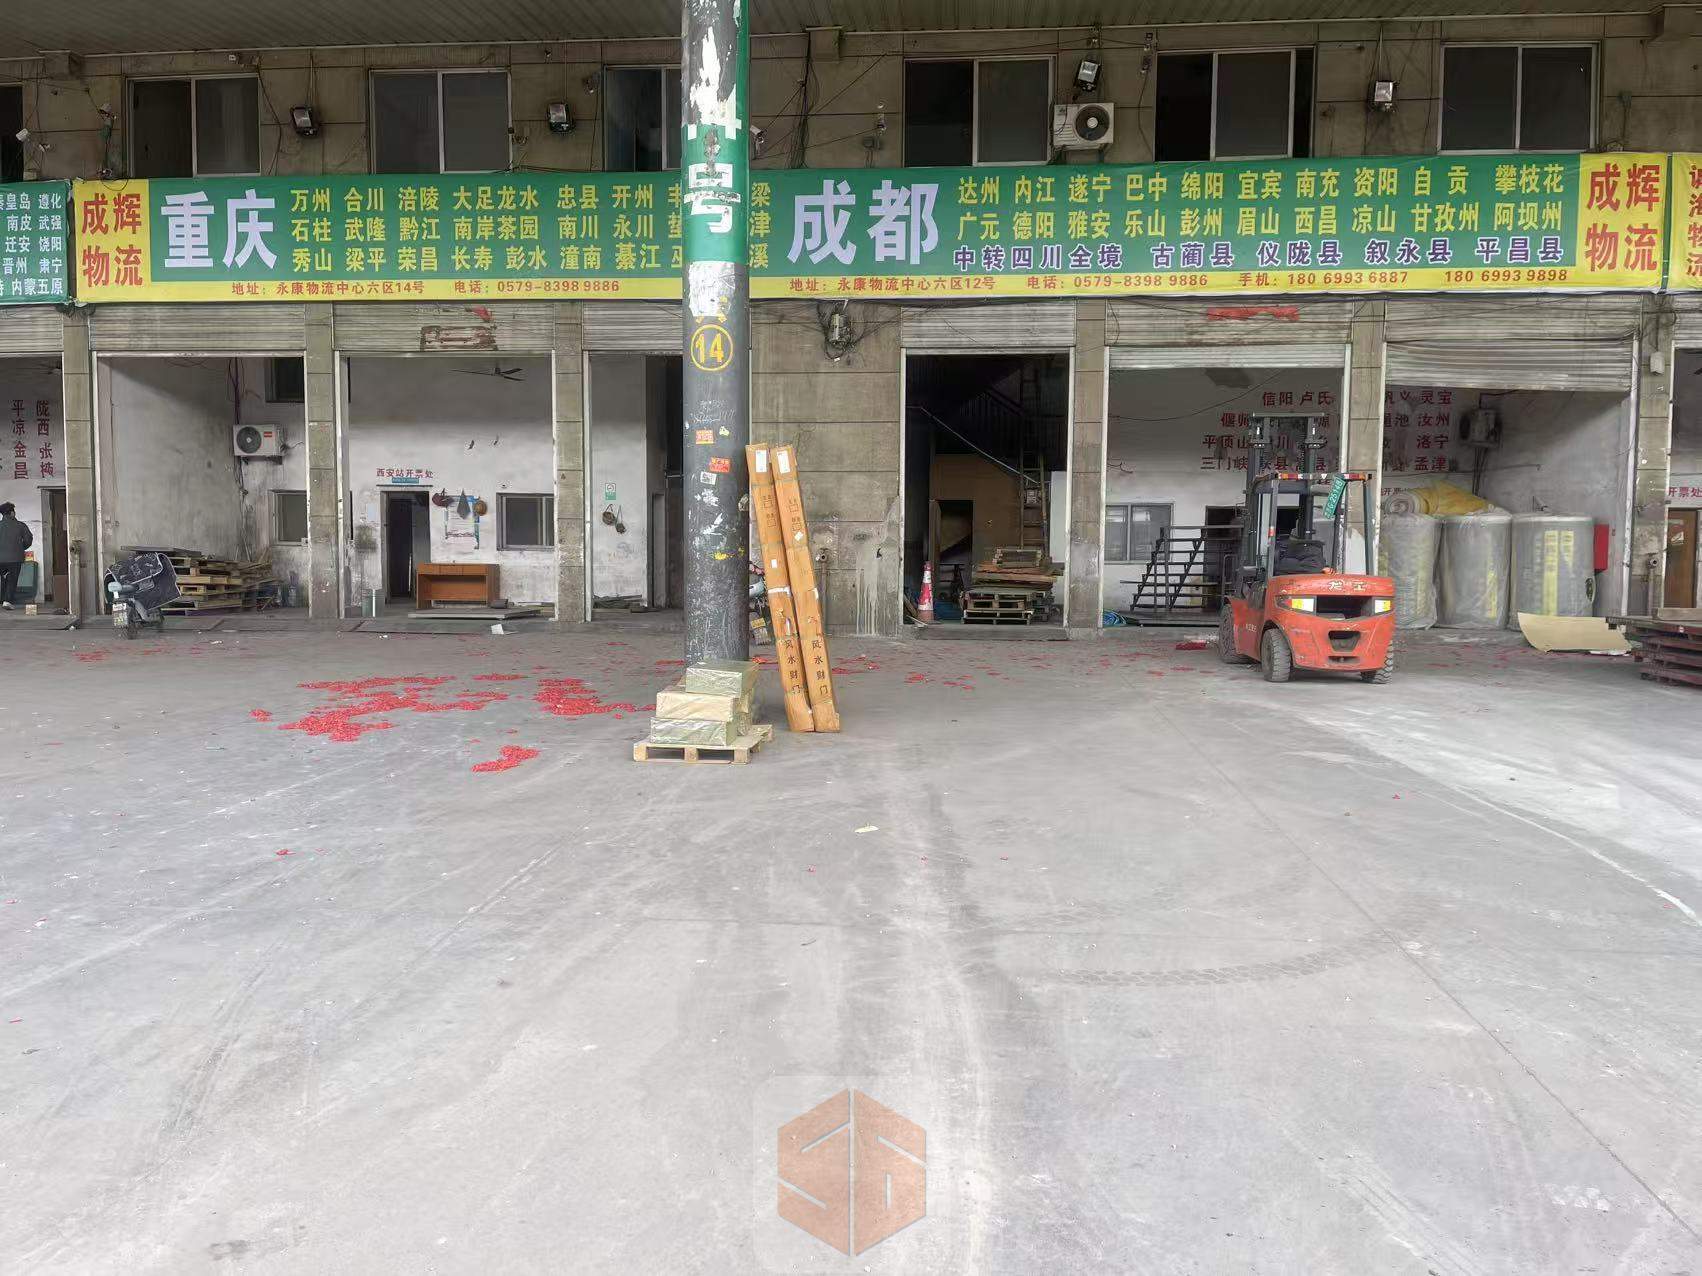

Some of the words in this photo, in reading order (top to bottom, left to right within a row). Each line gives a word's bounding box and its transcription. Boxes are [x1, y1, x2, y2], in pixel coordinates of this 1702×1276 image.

[290, 188, 331, 212] 万州
[344, 187, 384, 212] 合川
[398, 186, 440, 211] 涪陵
[452, 184, 539, 210] 大足龙水
[557, 184, 600, 210] 忠县
[612, 184, 653, 209] 开州
[958, 176, 1000, 204] 达州
[1014, 176, 1056, 203] 内江
[1068, 174, 1112, 202] 遂宁
[1125, 172, 1168, 202] 巴中
[1181, 171, 1224, 200] 绵阳
[1238, 170, 1282, 200] 宜宾
[1296, 168, 1339, 199] 南充
[1354, 167, 1398, 198] 资阳
[1495, 163, 1565, 195] 攀枝花
[1586, 162, 1660, 213] 成辉
[39, 193, 62, 210] 遵化
[81, 192, 142, 235] 成辉
[7, 214, 32, 232] 南皮
[39, 215, 62, 231] 武强
[160, 188, 278, 269] 重庆
[291, 218, 332, 243] 石柱
[344, 218, 386, 242] 武隆
[398, 216, 441, 240] 黔江
[453, 215, 540, 240] 南岸茶园
[557, 215, 600, 240] 南川
[612, 214, 654, 239] 永川
[787, 179, 940, 265] 成都
[957, 212, 1000, 240] 广元
[1013, 211, 1056, 239] 德阳
[1068, 209, 1112, 239] 雅安
[1124, 208, 1167, 238] 乐山
[1180, 207, 1223, 237] 彭州
[1237, 206, 1280, 236] 眉山
[1294, 206, 1337, 235] 西昌
[1352, 204, 1396, 234] 凉山
[1411, 201, 1479, 233] 甘孜州
[1494, 201, 1563, 232] 阿坝州
[5, 235, 31, 253] 迁安
[39, 236, 62, 252] 饶阳
[293, 247, 332, 272] 秀山
[346, 247, 387, 272] 梁平
[398, 247, 439, 272] 荣昌
[451, 247, 493, 270] 长寿
[506, 246, 548, 269] 彭水
[560, 246, 602, 270] 潼南
[615, 242, 662, 270] 綦江
[953, 244, 1123, 271] 中转四川全境
[1151, 241, 1235, 268] 古蔺县
[1257, 241, 1342, 267] 仪陇县
[1365, 237, 1452, 265] 叙永县
[1475, 236, 1564, 264] 平昌县
[1585, 222, 1659, 273] 物流
[2, 257, 28, 275] 晋州
[39, 258, 63, 274] 肃宁
[81, 246, 144, 287] 物流
[11, 278, 63, 296] 内蒙五原
[695, 333, 725, 364] 14
[1263, 391, 1294, 407] 信阳
[1300, 391, 1334, 406] 卢氏
[1421, 390, 1452, 405] 灵宝
[36, 400, 50, 436] 陇西
[1418, 412, 1450, 427] 汝州
[1203, 435, 1248, 449] 平顶山
[1416, 433, 1449, 449] 洛宁
[14, 441, 29, 480] 金昌
[376, 467, 433, 479] 西安站开票处
[1200, 455, 1248, 470] 三门峡
[1415, 456, 1446, 471] 孟津
[812, 640, 829, 696] 风水财门
